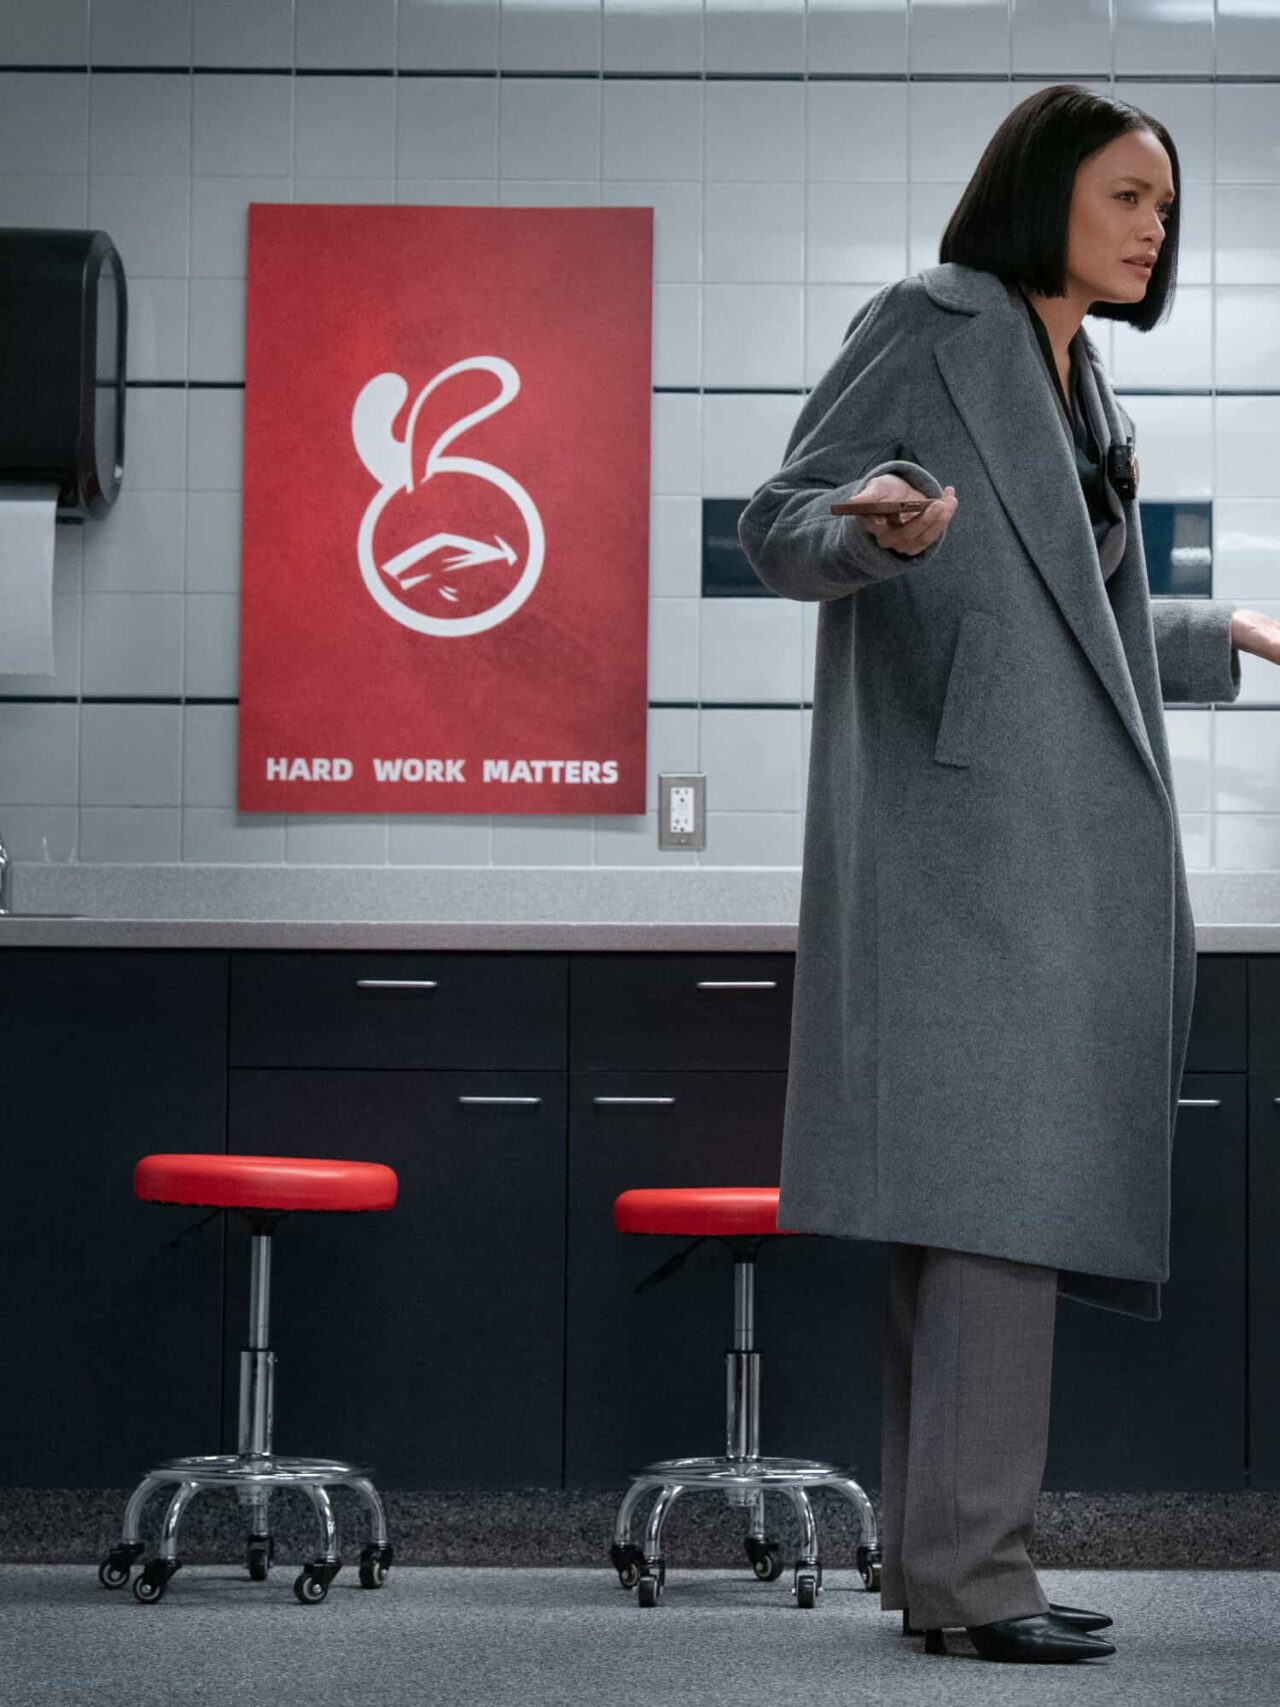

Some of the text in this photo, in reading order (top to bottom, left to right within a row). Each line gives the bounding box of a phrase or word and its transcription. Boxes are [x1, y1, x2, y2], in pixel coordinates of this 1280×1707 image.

[266, 757, 619, 785] HARD WORK MATTERS
